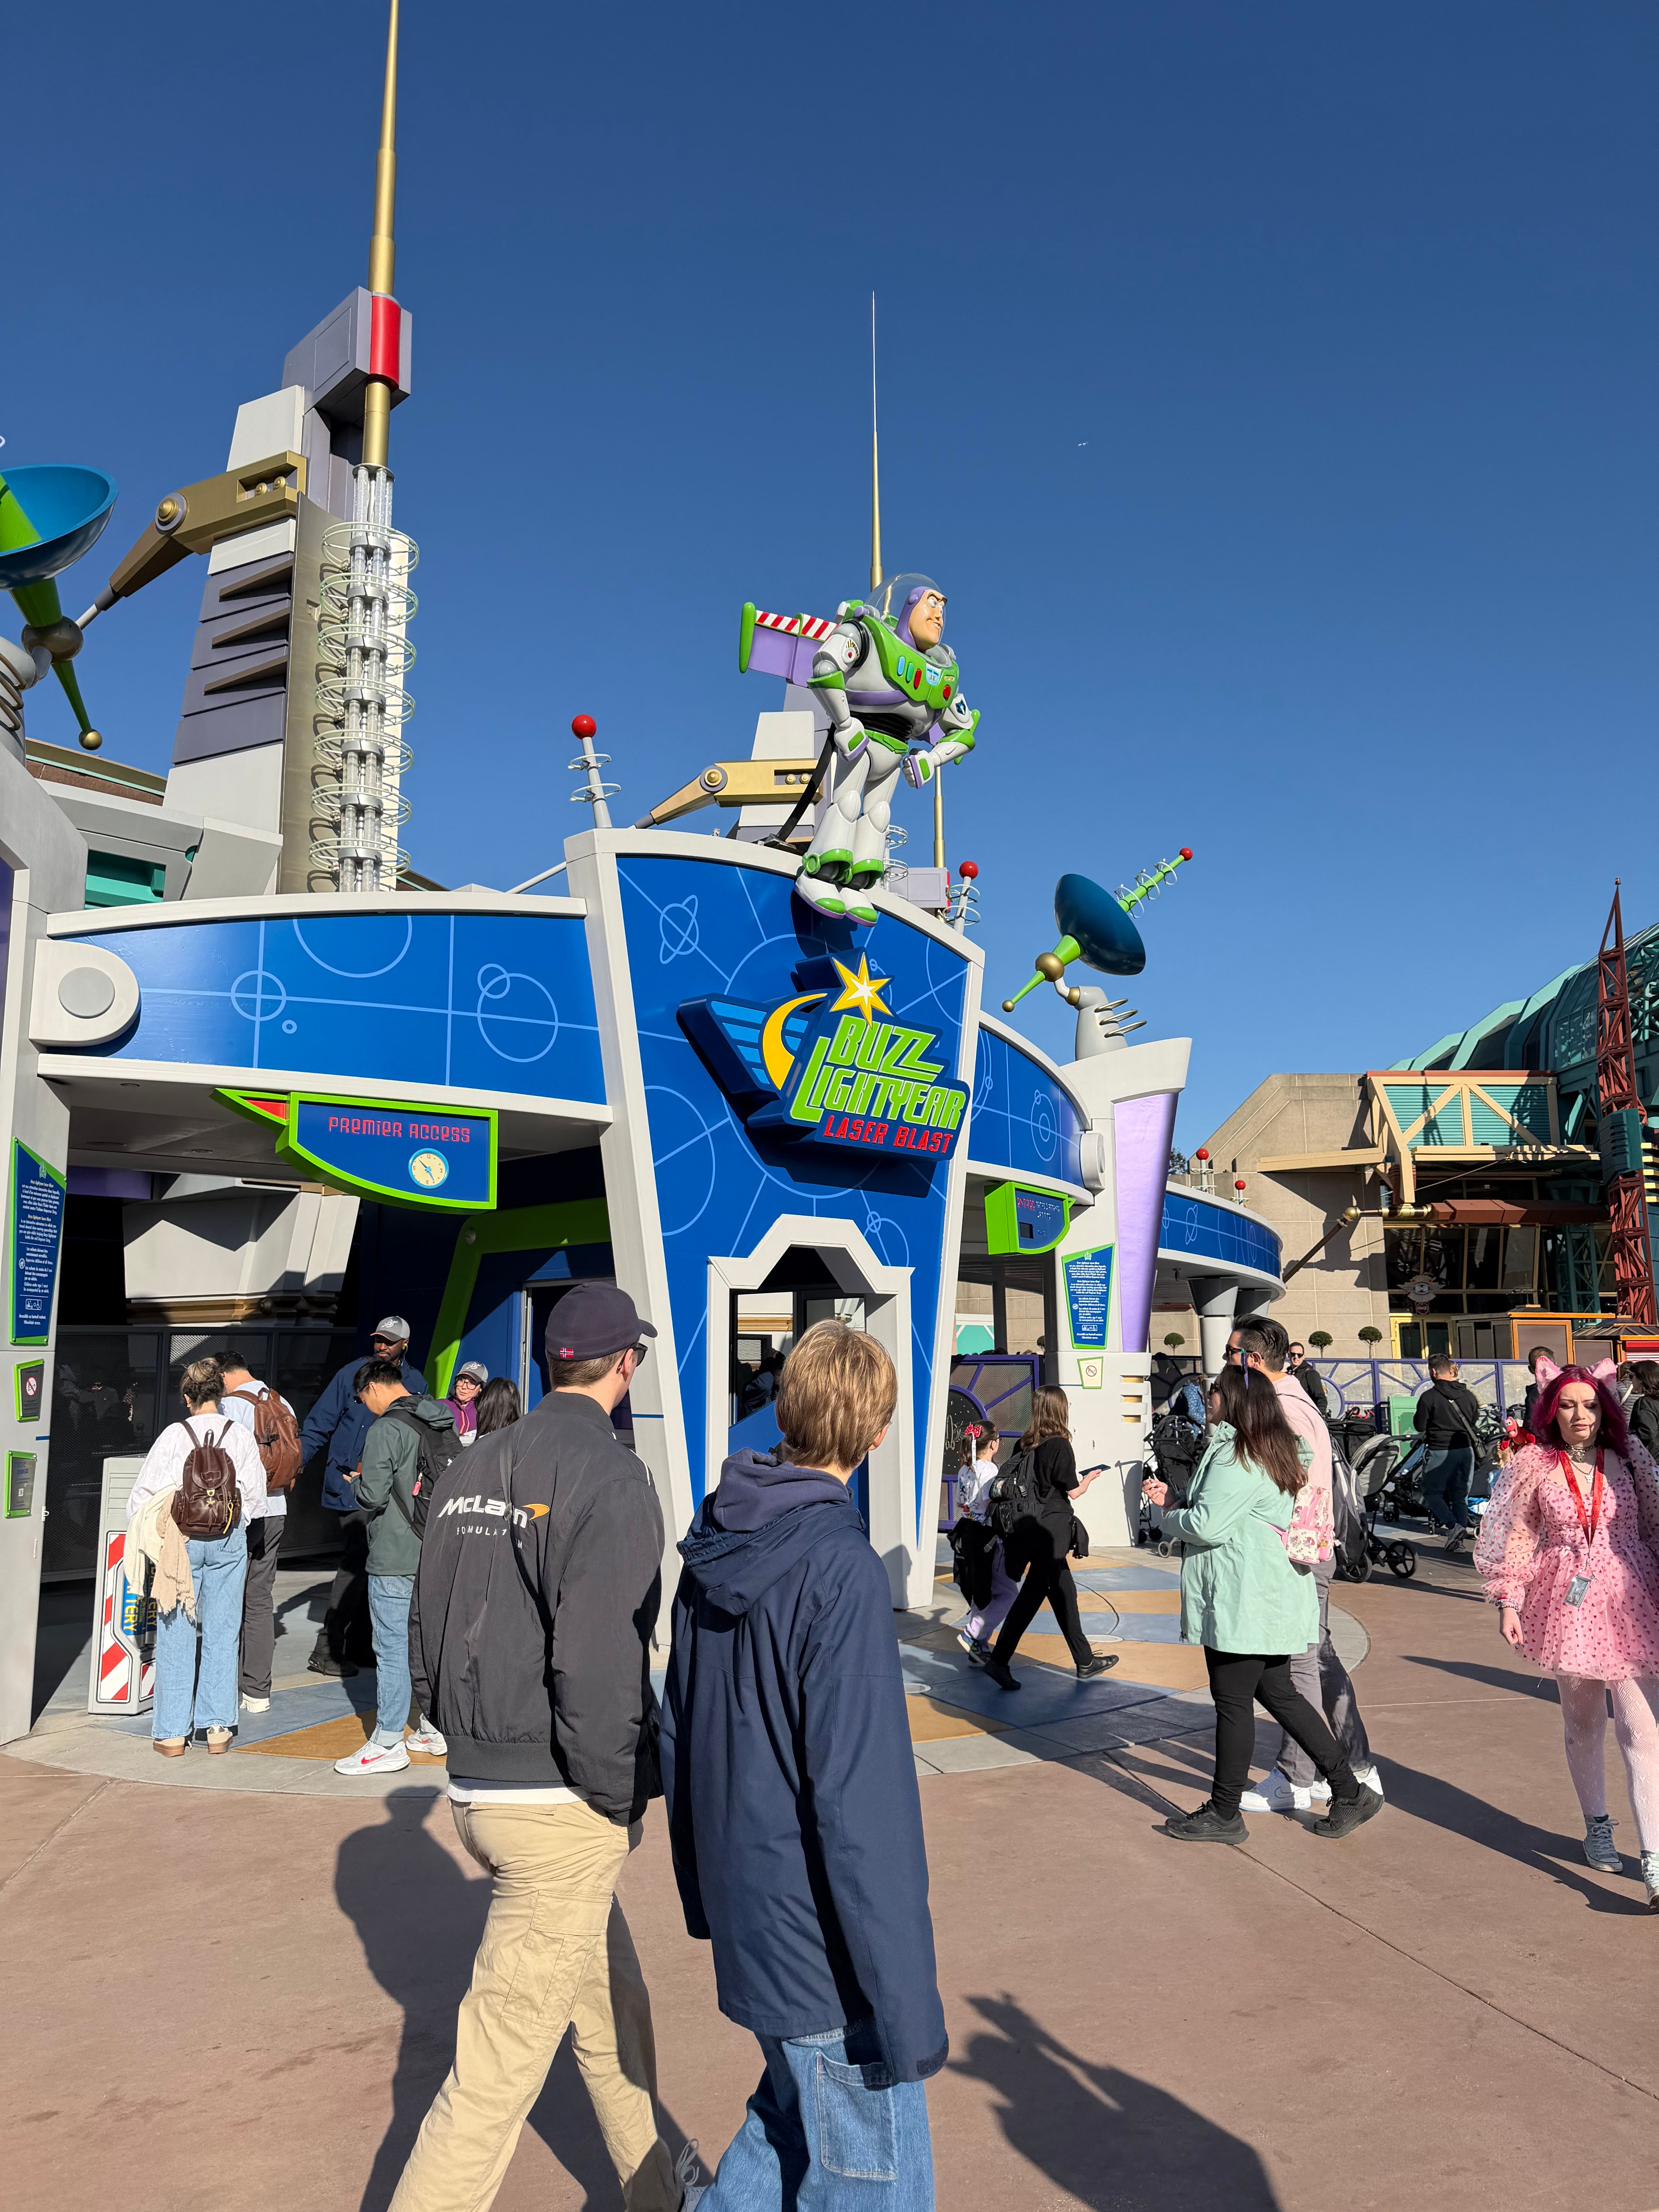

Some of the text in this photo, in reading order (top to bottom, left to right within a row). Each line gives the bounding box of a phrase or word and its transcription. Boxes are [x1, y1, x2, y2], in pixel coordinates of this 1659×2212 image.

[825, 1014, 945, 1083] BUZZ
[790, 1036, 966, 1130] LIGHTYEAR
[409, 1123, 470, 1143] ACCESS
[823, 1115, 953, 1154] LASER BLAST
[436, 1495, 527, 1528] McLan
